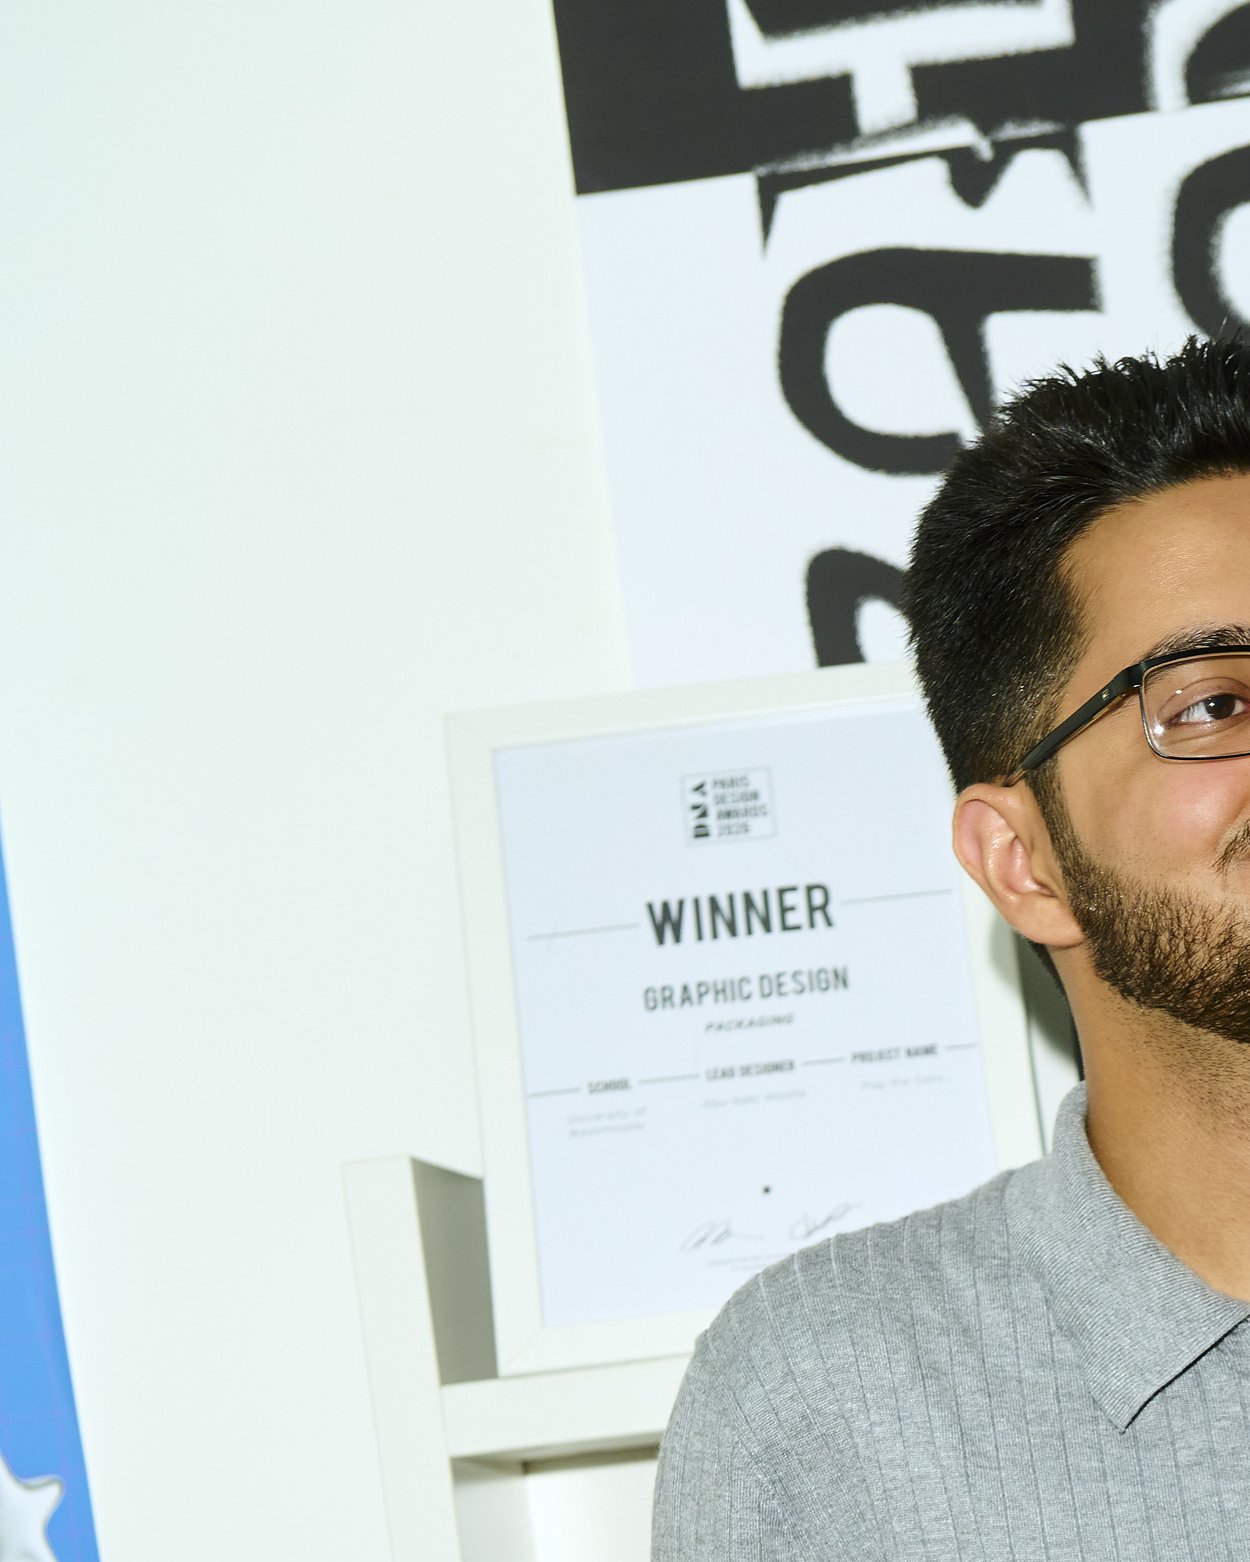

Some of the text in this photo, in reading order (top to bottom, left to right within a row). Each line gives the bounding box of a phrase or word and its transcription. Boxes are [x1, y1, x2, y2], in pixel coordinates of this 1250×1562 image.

[716, 805, 768, 821] AWARDS
[645, 883, 834, 946] WINNER
[643, 966, 849, 1012] GRAPHIC DESIGN
[704, 1012, 794, 1033] PACKAGING
[851, 1043, 938, 1064] PROJECT NAME
[705, 1059, 795, 1081] LEAD DESIGNER
[588, 1078, 631, 1094] SCHOOL
